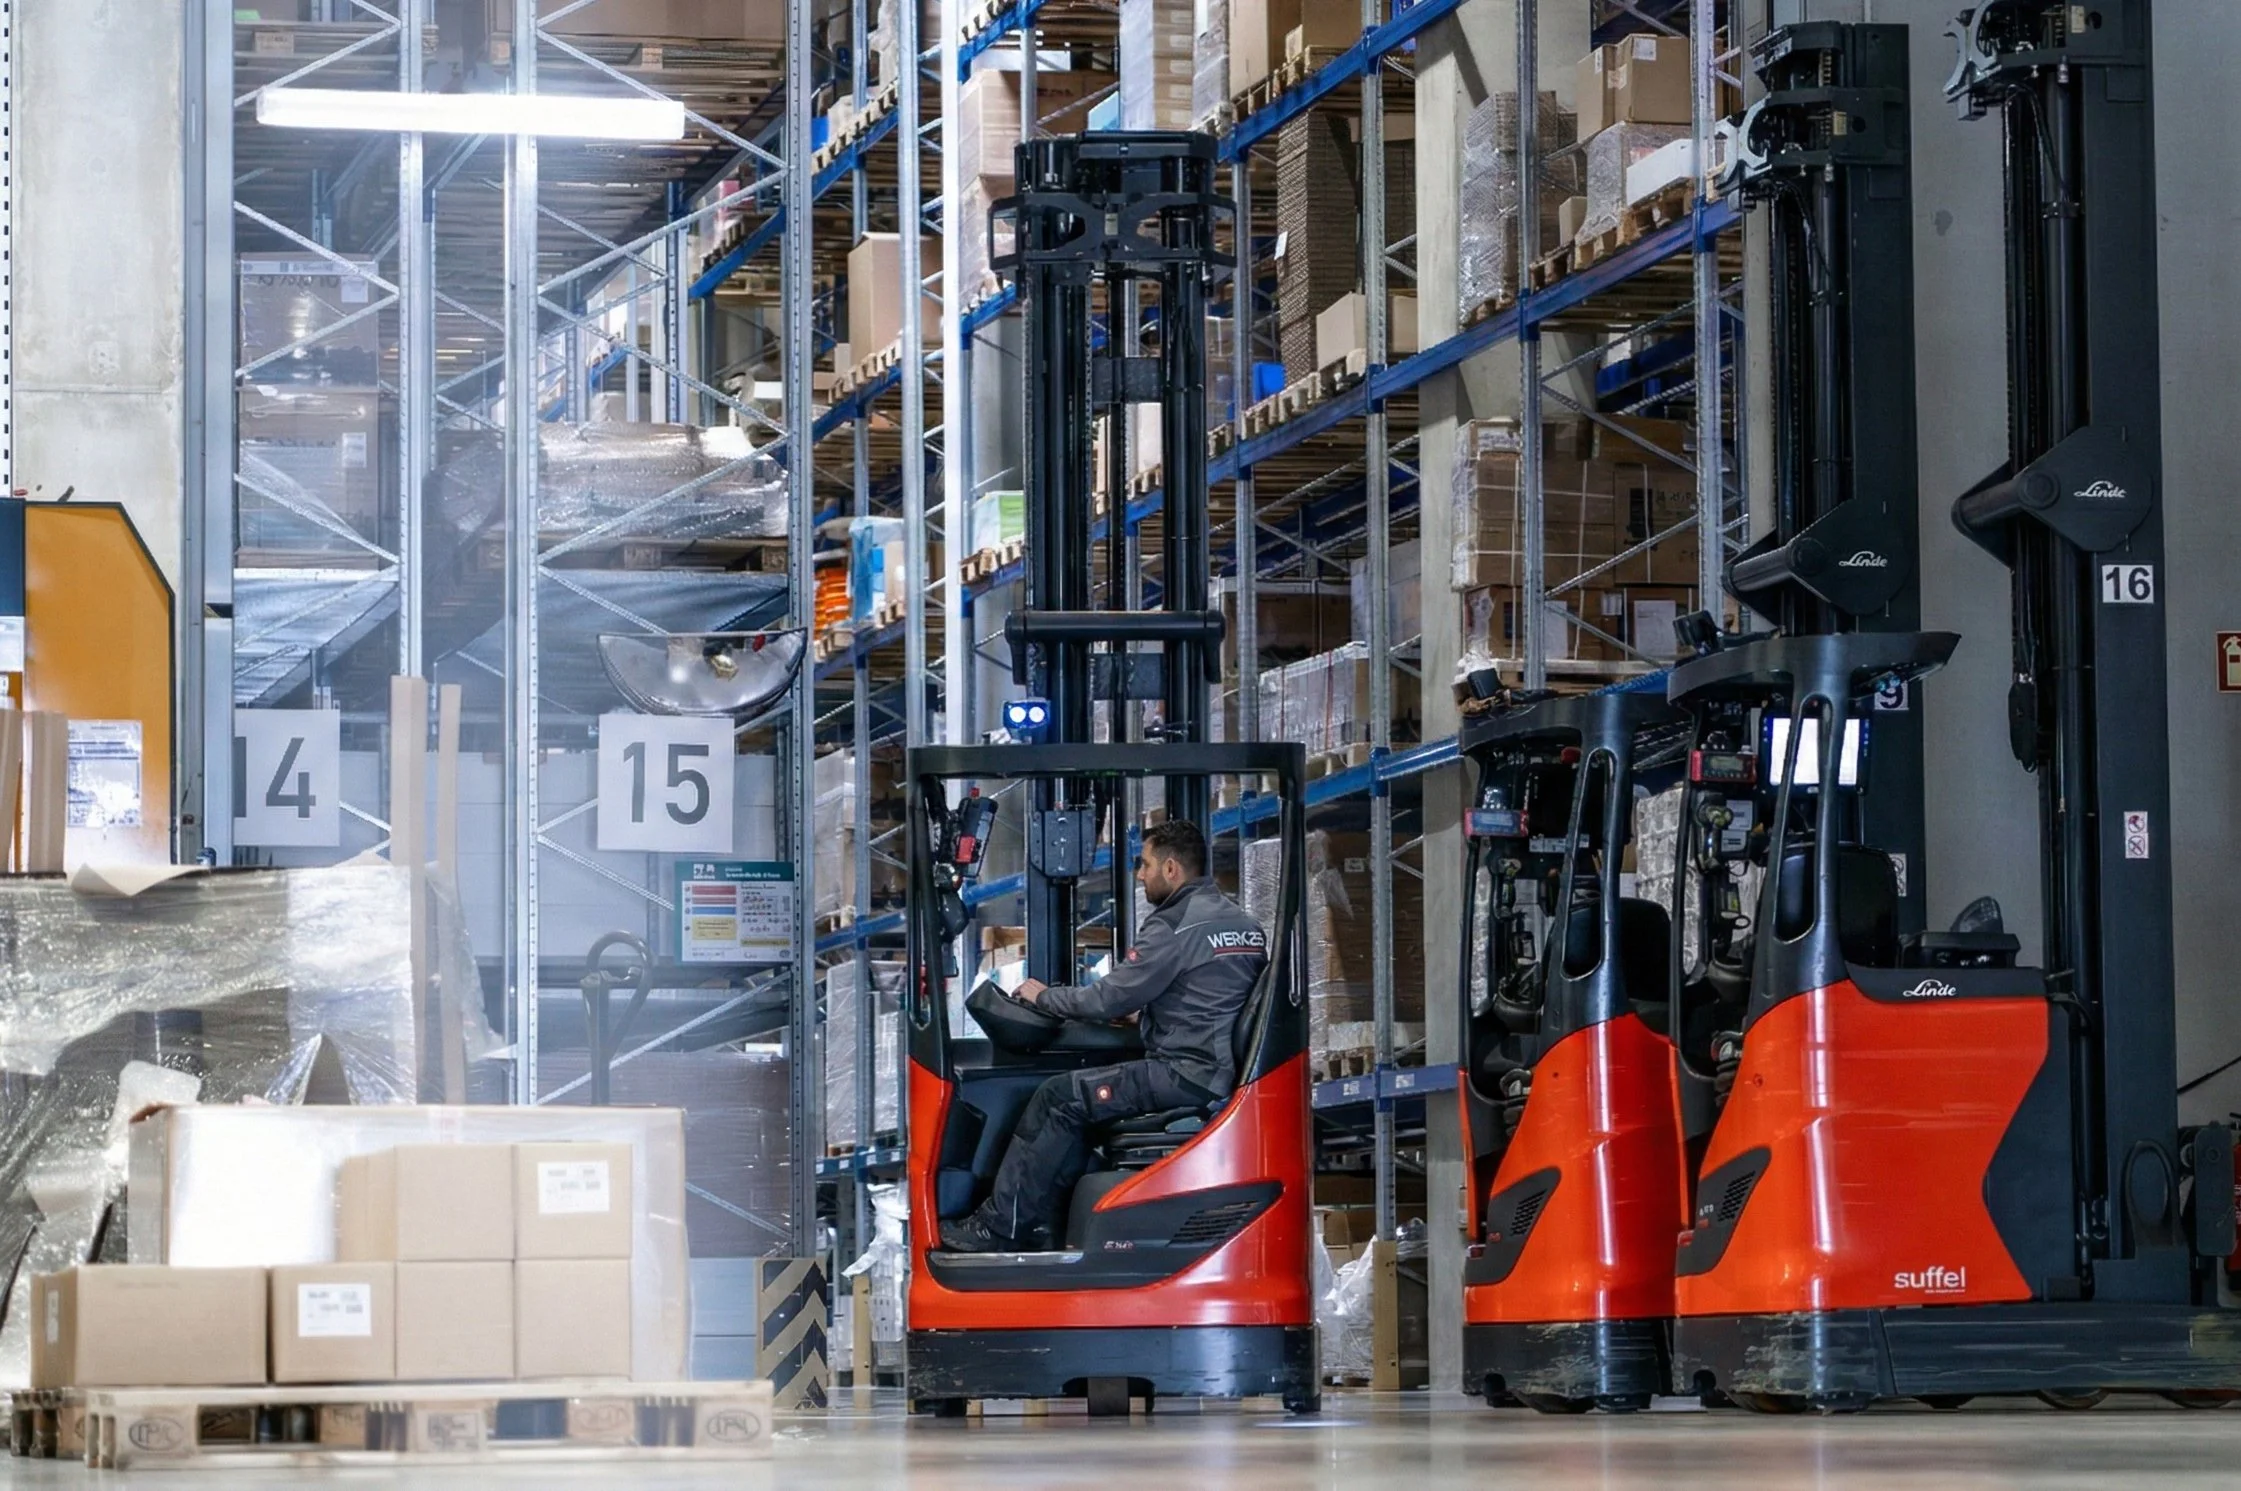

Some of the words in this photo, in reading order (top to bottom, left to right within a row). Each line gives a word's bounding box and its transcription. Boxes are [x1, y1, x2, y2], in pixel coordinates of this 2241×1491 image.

[2074, 480, 2126, 498] Linde
[1838, 551, 1888, 567] Linde
[2105, 566, 2151, 601] 16
[1879, 681, 1904, 709] 9
[623, 742, 710, 825] 15
[1902, 979, 1957, 997] Linde
[1894, 1266, 1966, 1288] suffel
